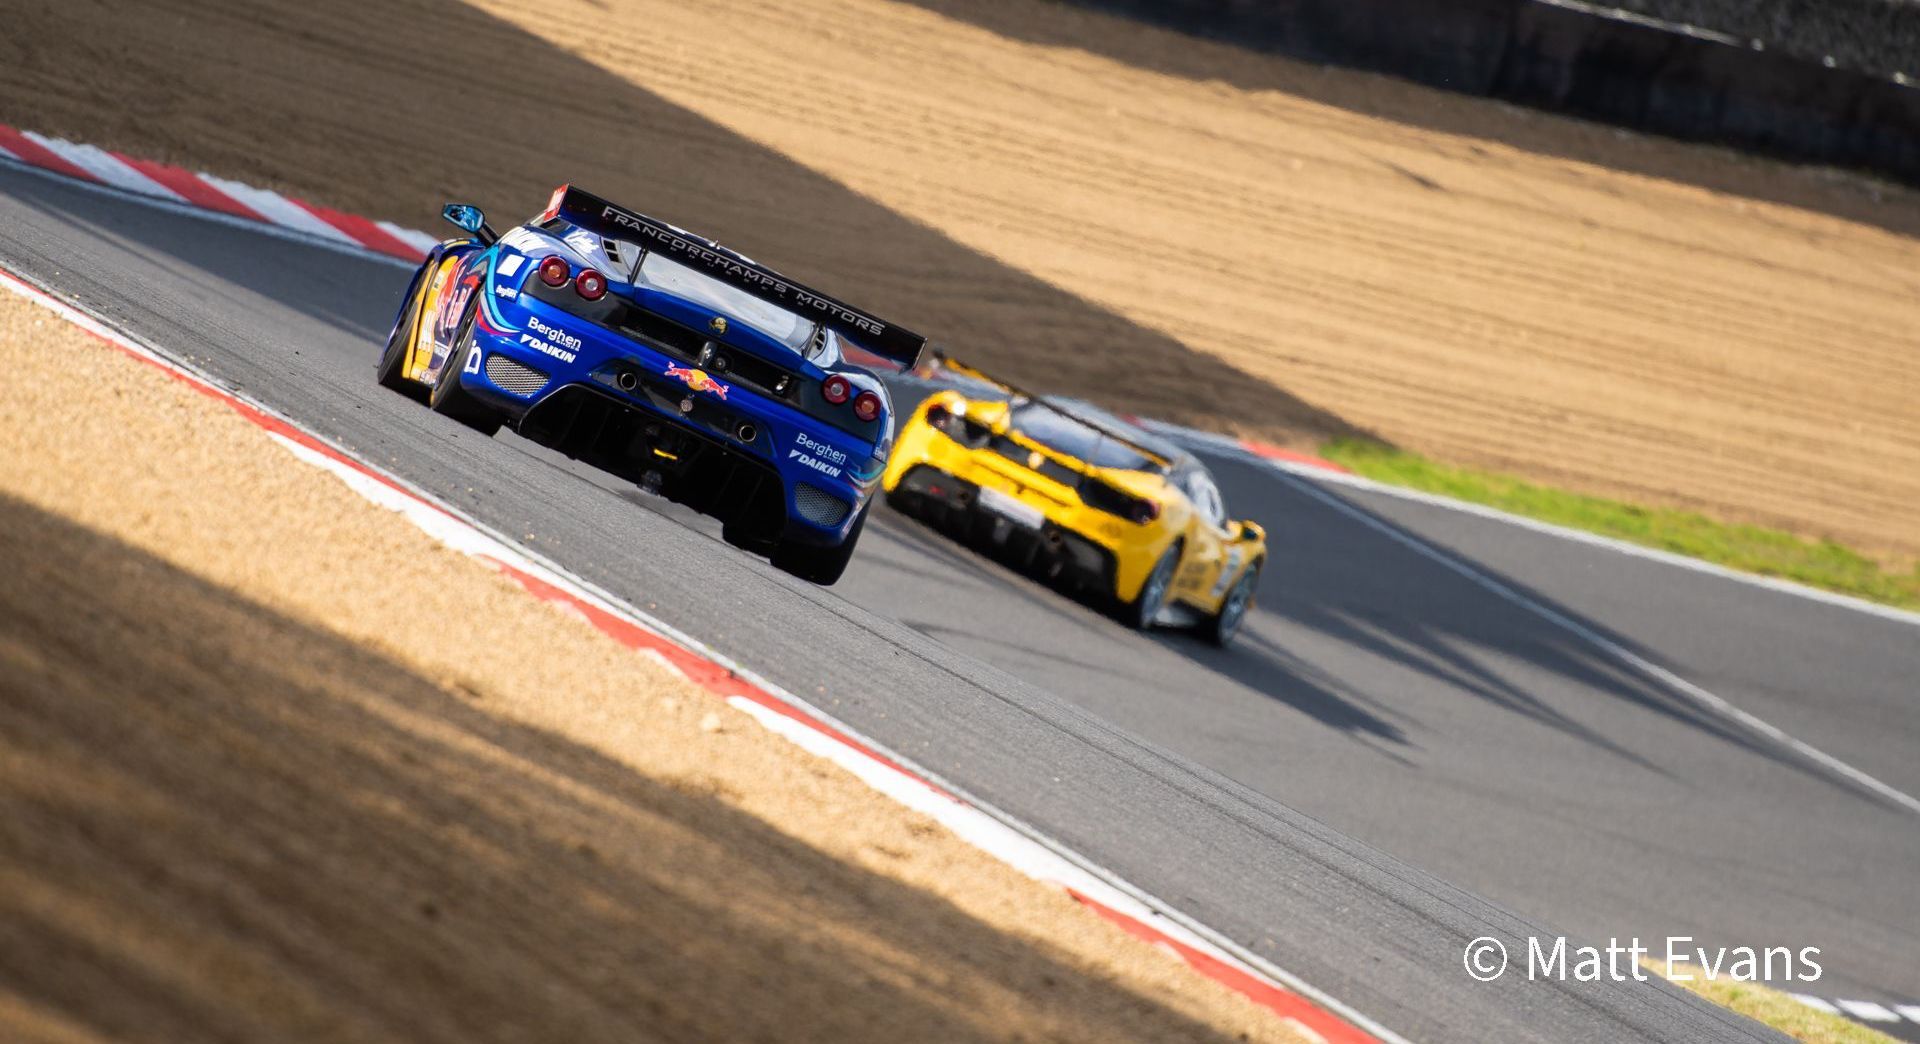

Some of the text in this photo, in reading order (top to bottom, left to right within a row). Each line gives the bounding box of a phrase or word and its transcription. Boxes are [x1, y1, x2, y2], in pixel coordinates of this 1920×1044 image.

[602, 206, 788, 293] FRANCORCHAMPS
[796, 293, 886, 336] MOTORS
[528, 316, 582, 348] Berghen
[529, 338, 576, 363] DAIKIN
[796, 433, 847, 464] Berghen
[798, 454, 842, 478] DAIKIN
